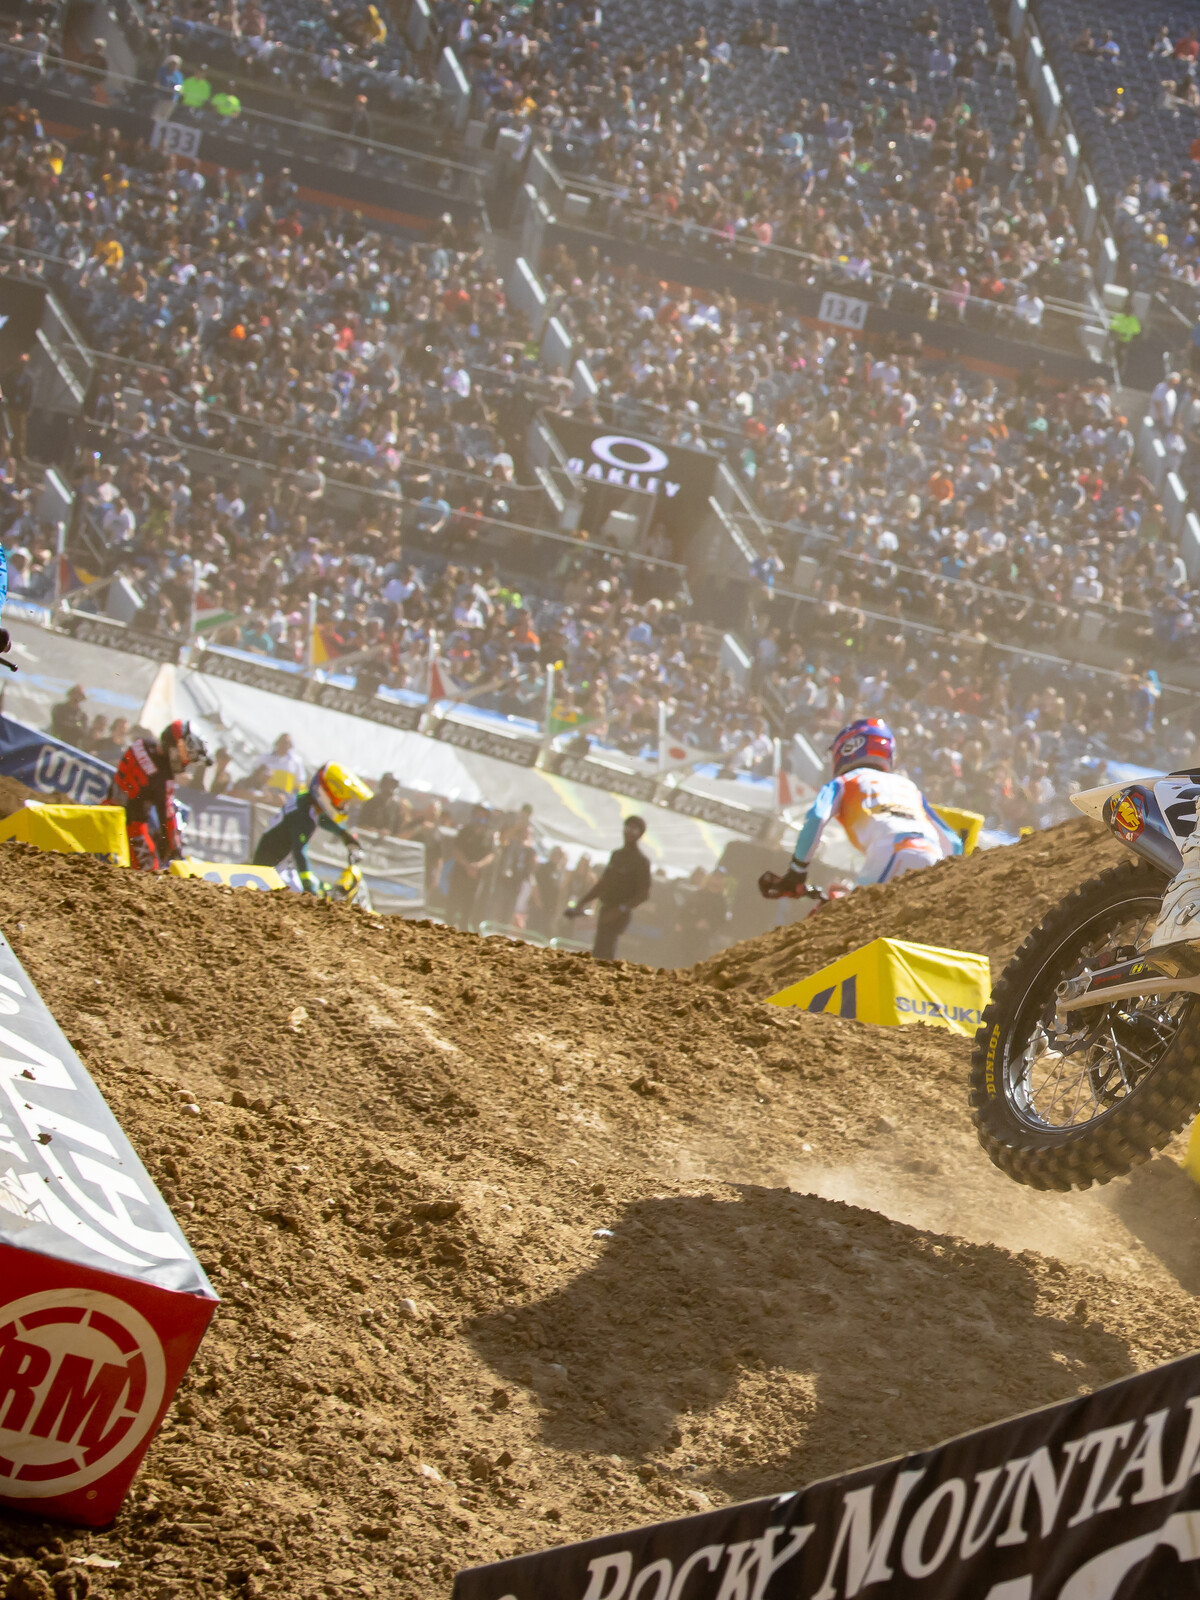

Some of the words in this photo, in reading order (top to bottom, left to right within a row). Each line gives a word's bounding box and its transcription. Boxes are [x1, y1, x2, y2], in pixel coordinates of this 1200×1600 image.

[159, 126, 195, 152] 133
[825, 297, 862, 324] 134
[34, 744, 116, 804] WP
[896, 996, 981, 1025] SUZUKI
[986, 1024, 1000, 1093] DUNLOP
[0, 1338, 128, 1450] RM
